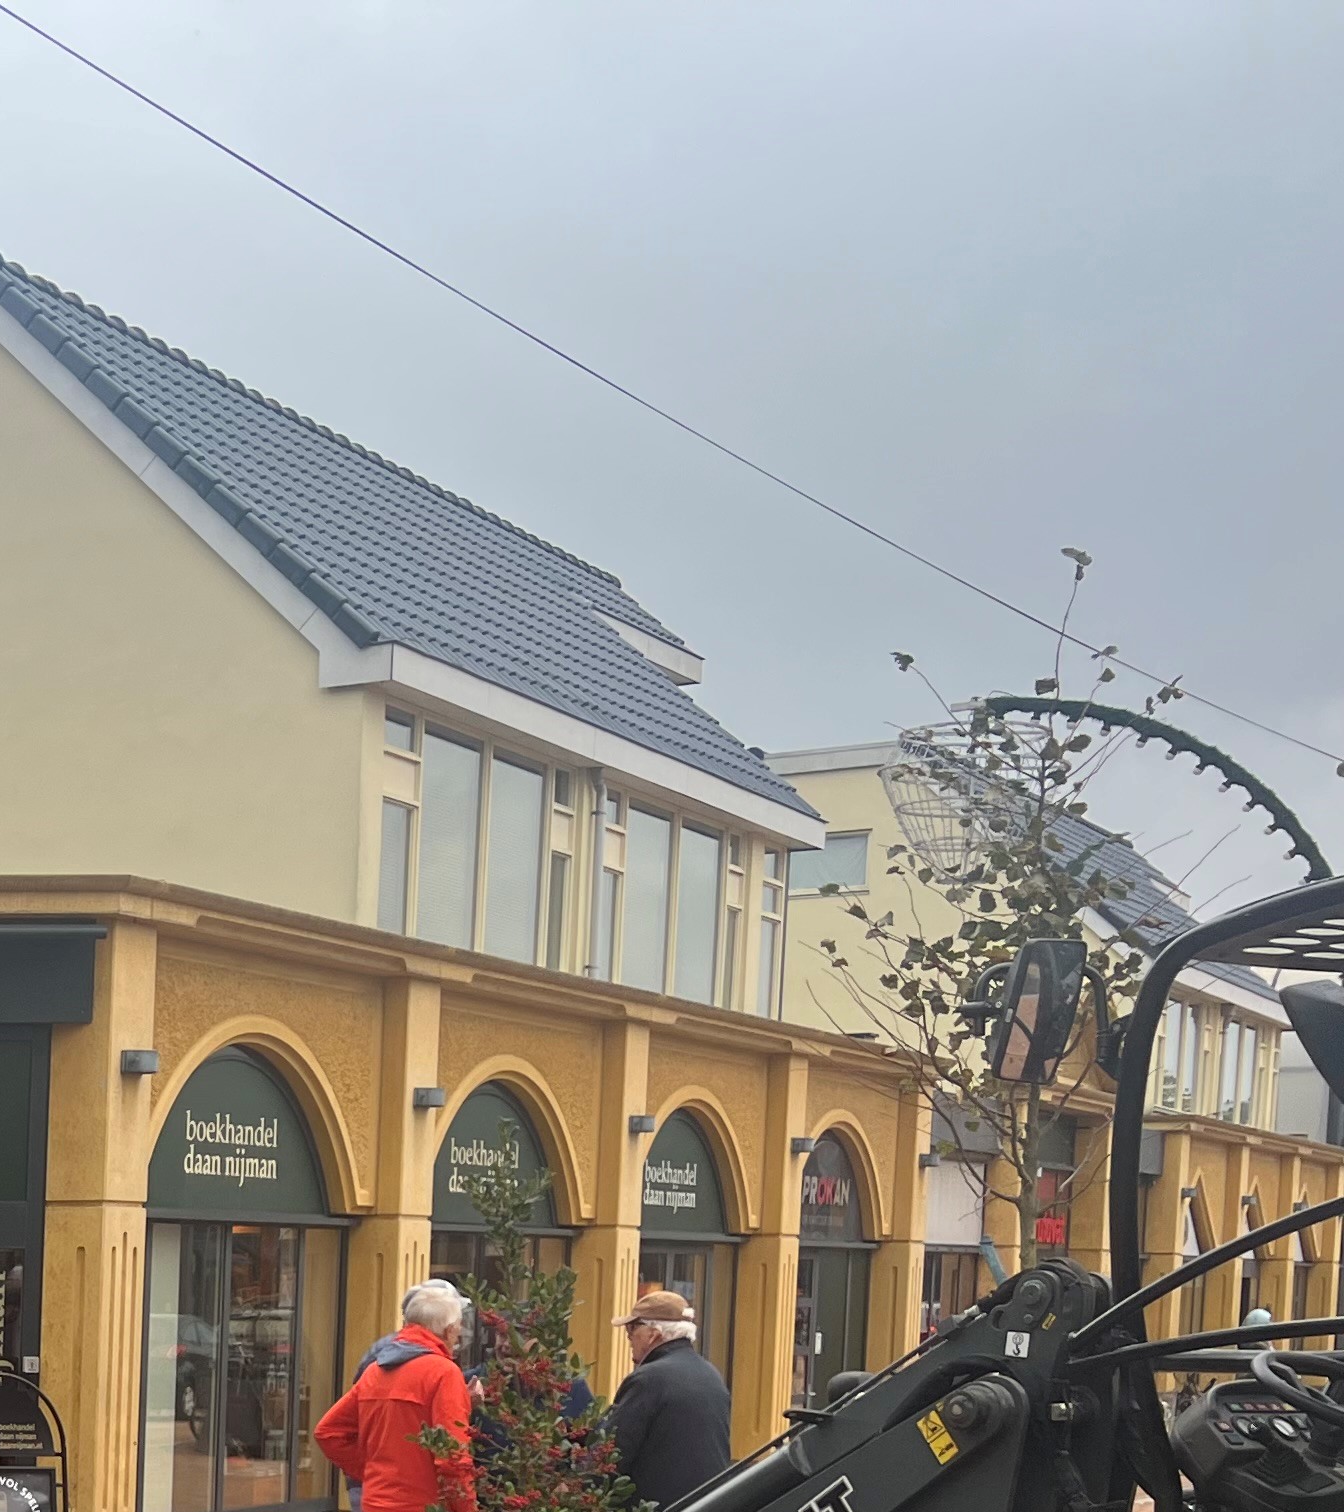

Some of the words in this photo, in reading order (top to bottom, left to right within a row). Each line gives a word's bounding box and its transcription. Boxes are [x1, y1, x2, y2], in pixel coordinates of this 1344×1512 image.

[185, 1109, 278, 1148] boekhandel
[183, 1143, 221, 1175] daan
[224, 1148, 278, 1188] nijman
[645, 1159, 698, 1186] boekhandel
[643, 1182, 665, 1206] daan
[665, 1184, 696, 1215] nijman
[802, 1175, 851, 1207] PROKAN
